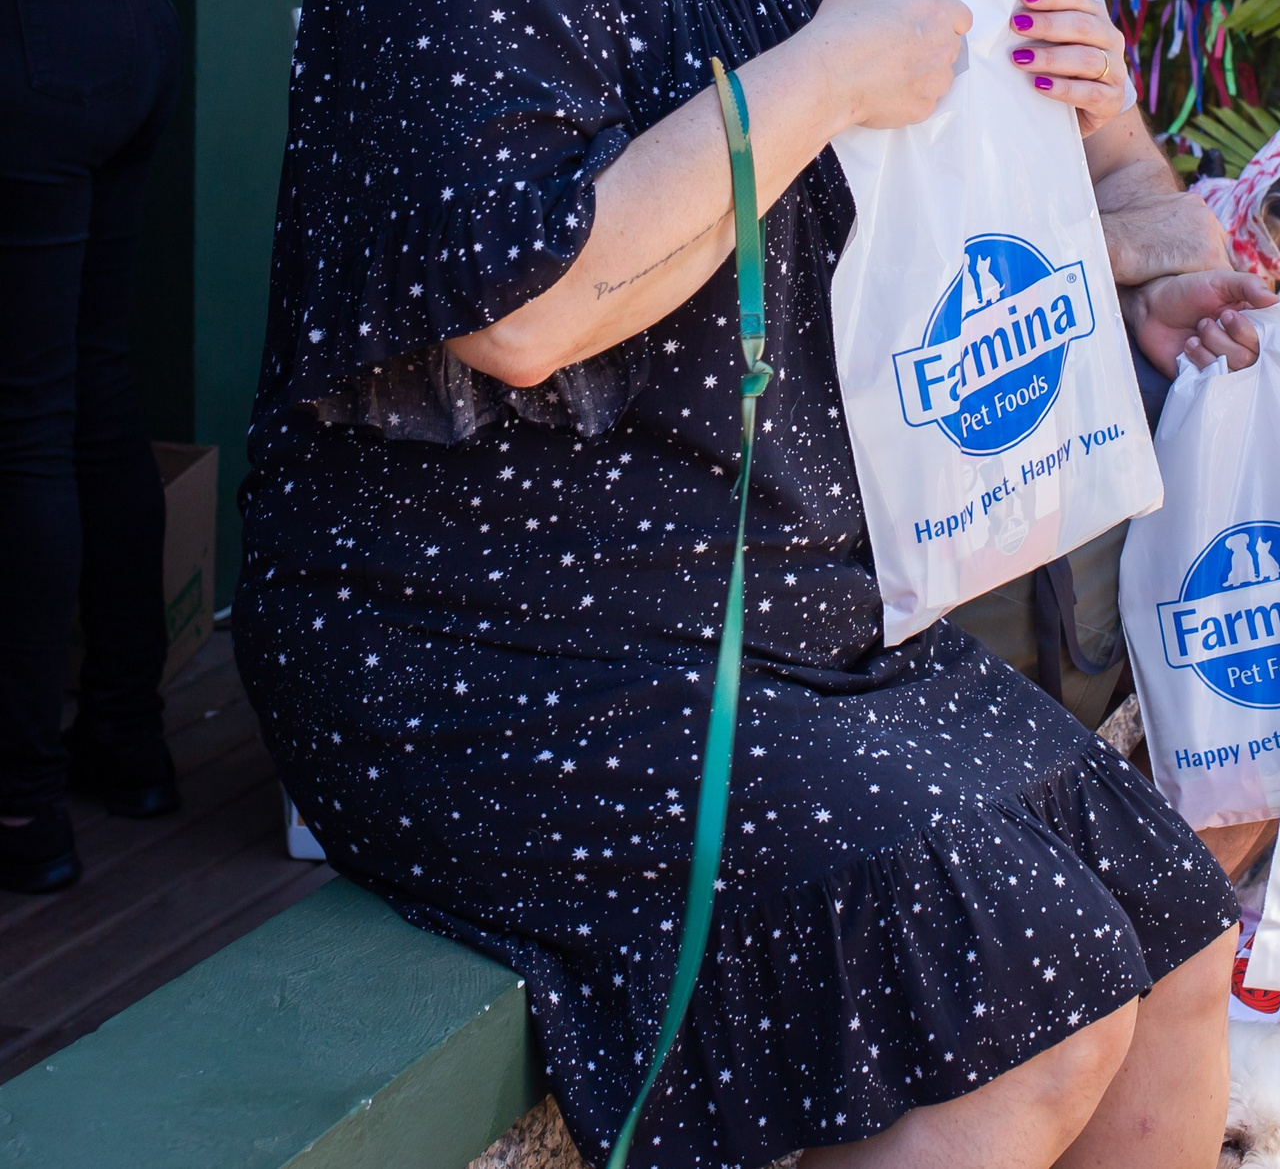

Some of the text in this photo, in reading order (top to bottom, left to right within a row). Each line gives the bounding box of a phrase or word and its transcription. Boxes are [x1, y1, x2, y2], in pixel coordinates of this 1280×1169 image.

[912, 295, 1077, 412] Farmina
[960, 374, 1048, 438] Pet Foods
[912, 423, 1125, 544] Happy pet. Happy you.
[1227, 663, 1262, 688] Pet
[1175, 744, 1240, 770] Happy
